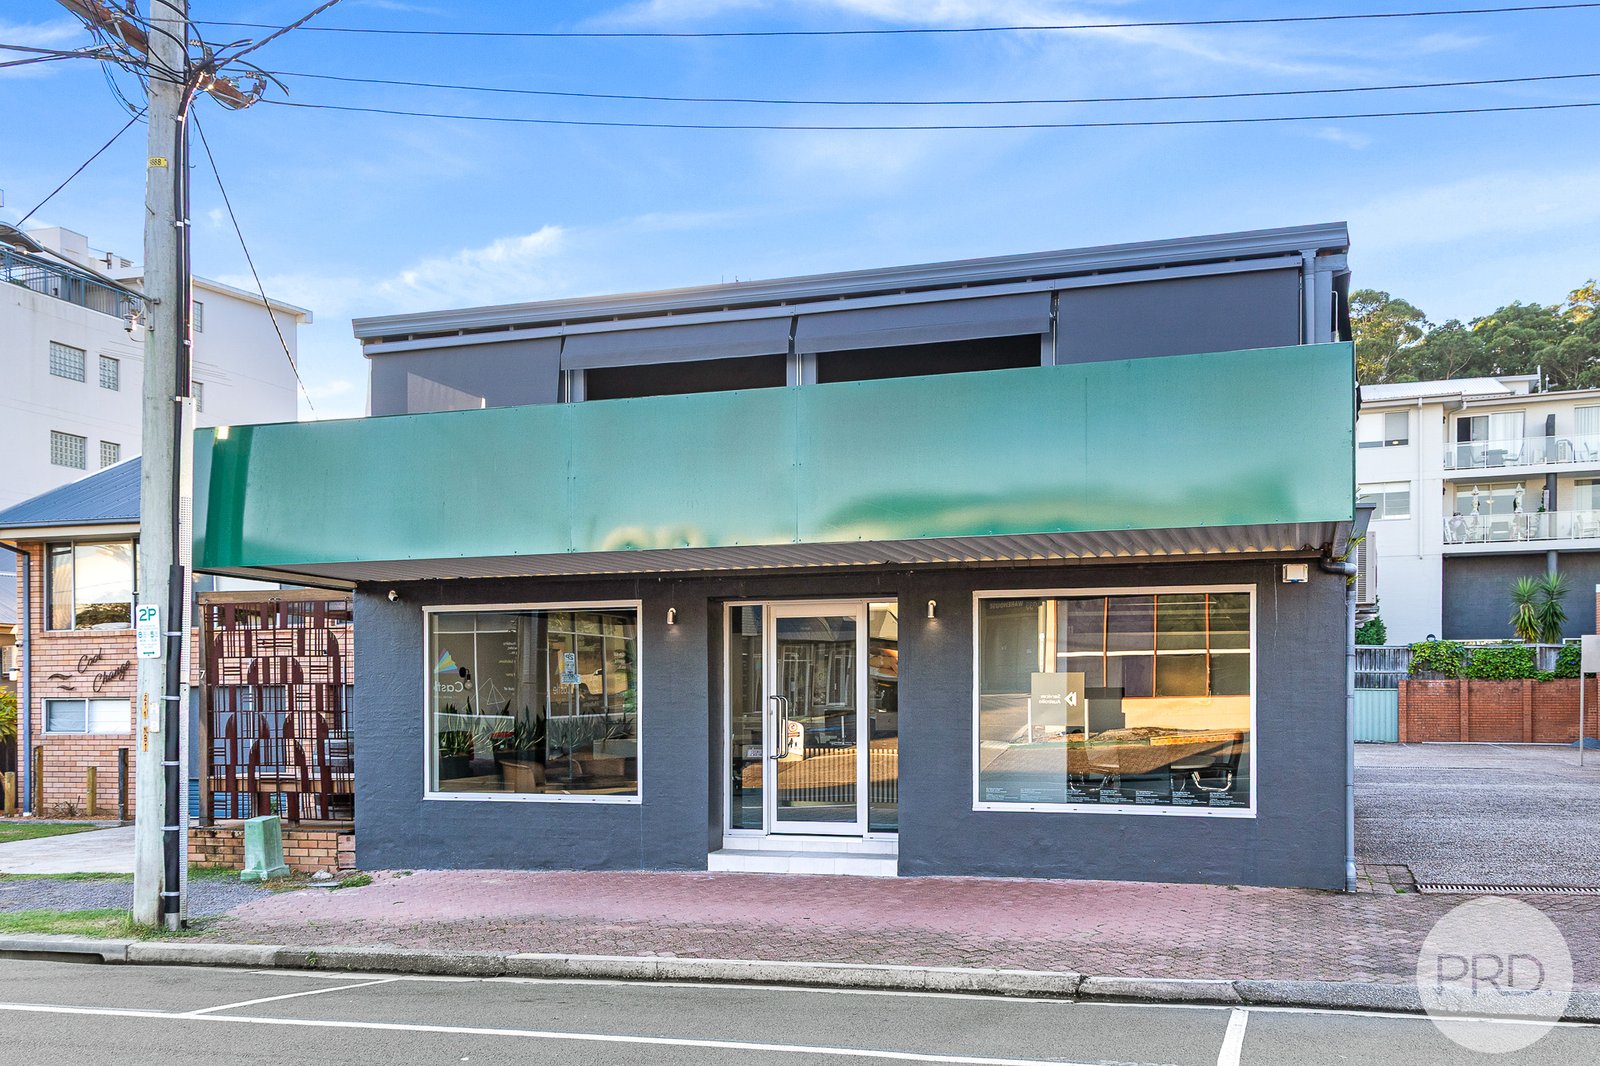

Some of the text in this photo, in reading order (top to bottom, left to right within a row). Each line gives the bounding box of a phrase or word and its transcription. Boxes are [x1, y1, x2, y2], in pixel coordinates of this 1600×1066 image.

[138, 608, 157, 621] 2P
[77, 647, 103, 674] Cool
[93, 660, 131, 693] Change
[199, 669, 206, 679] 7
